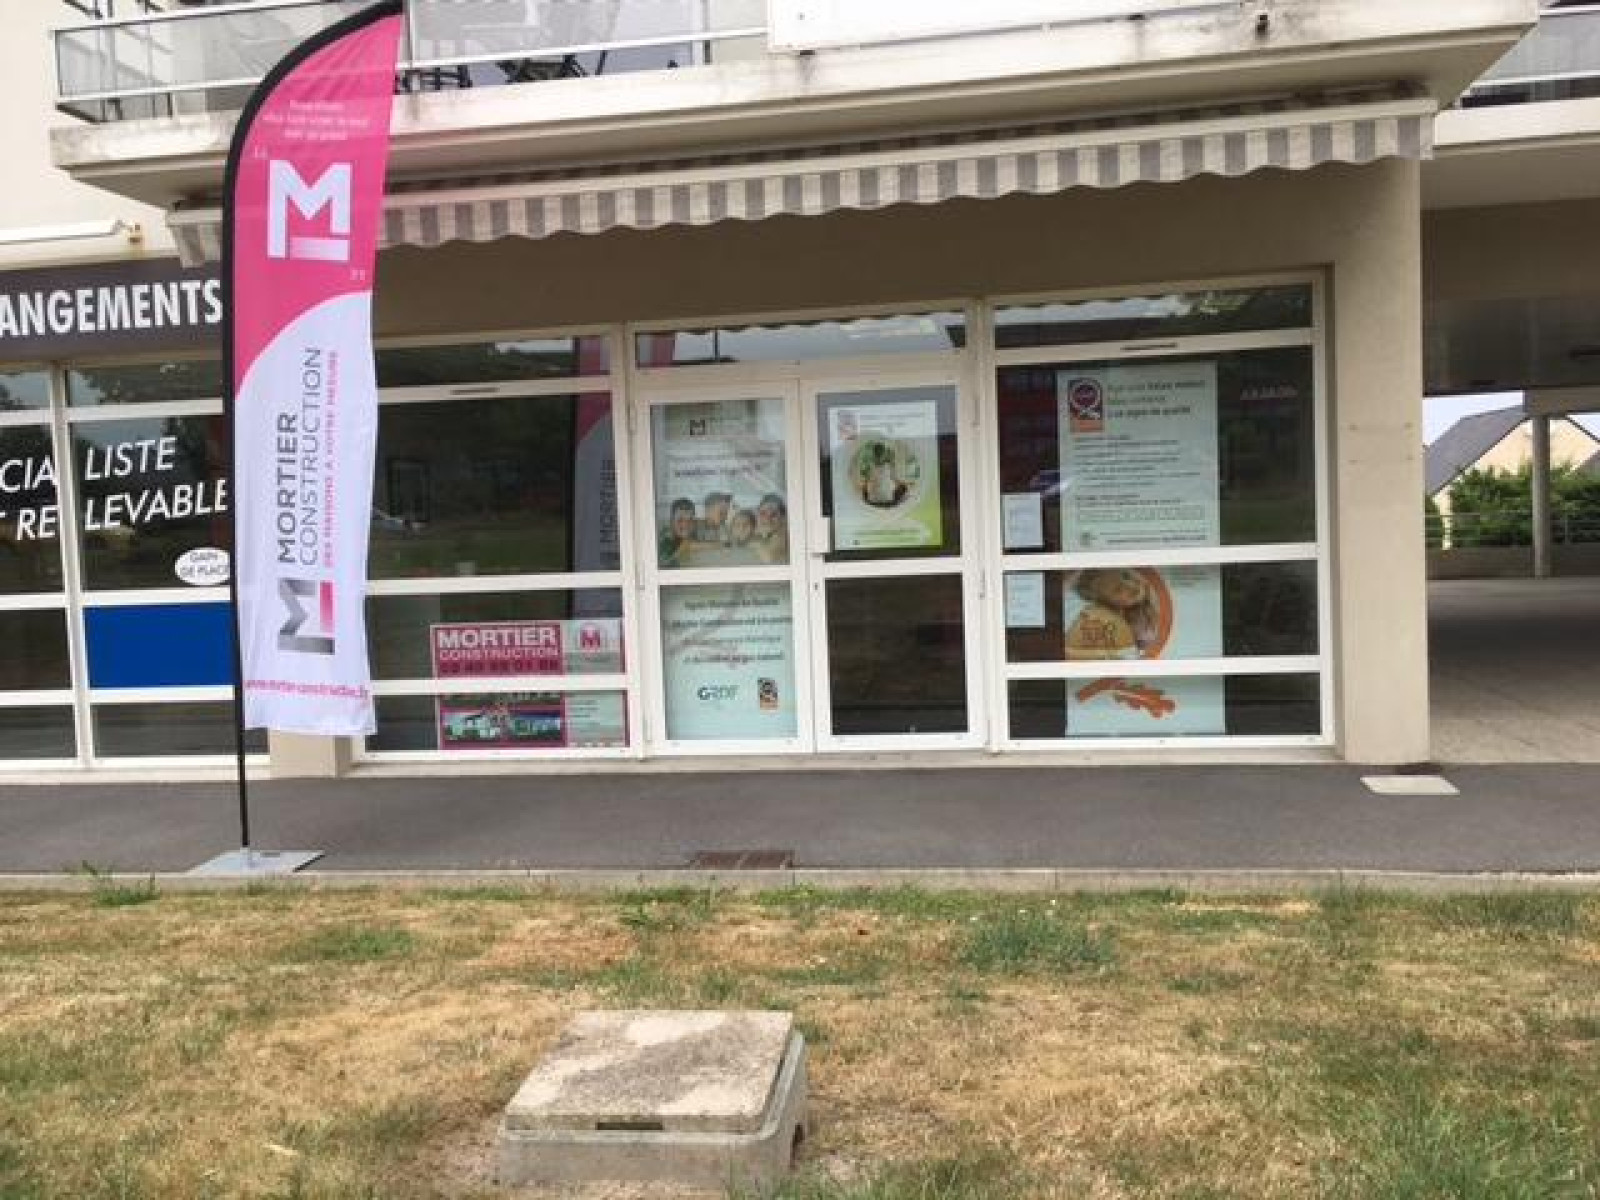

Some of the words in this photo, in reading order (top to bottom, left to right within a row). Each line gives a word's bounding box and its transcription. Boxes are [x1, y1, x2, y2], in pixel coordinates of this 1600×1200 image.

[0, 279, 223, 337] ANGEMENTS
[300, 347, 321, 566] CONSTRUCTION
[277, 413, 297, 564] MORTIER
[437, 627, 556, 649] MORTIER
[439, 646, 558, 660] CONSTRUCTION
